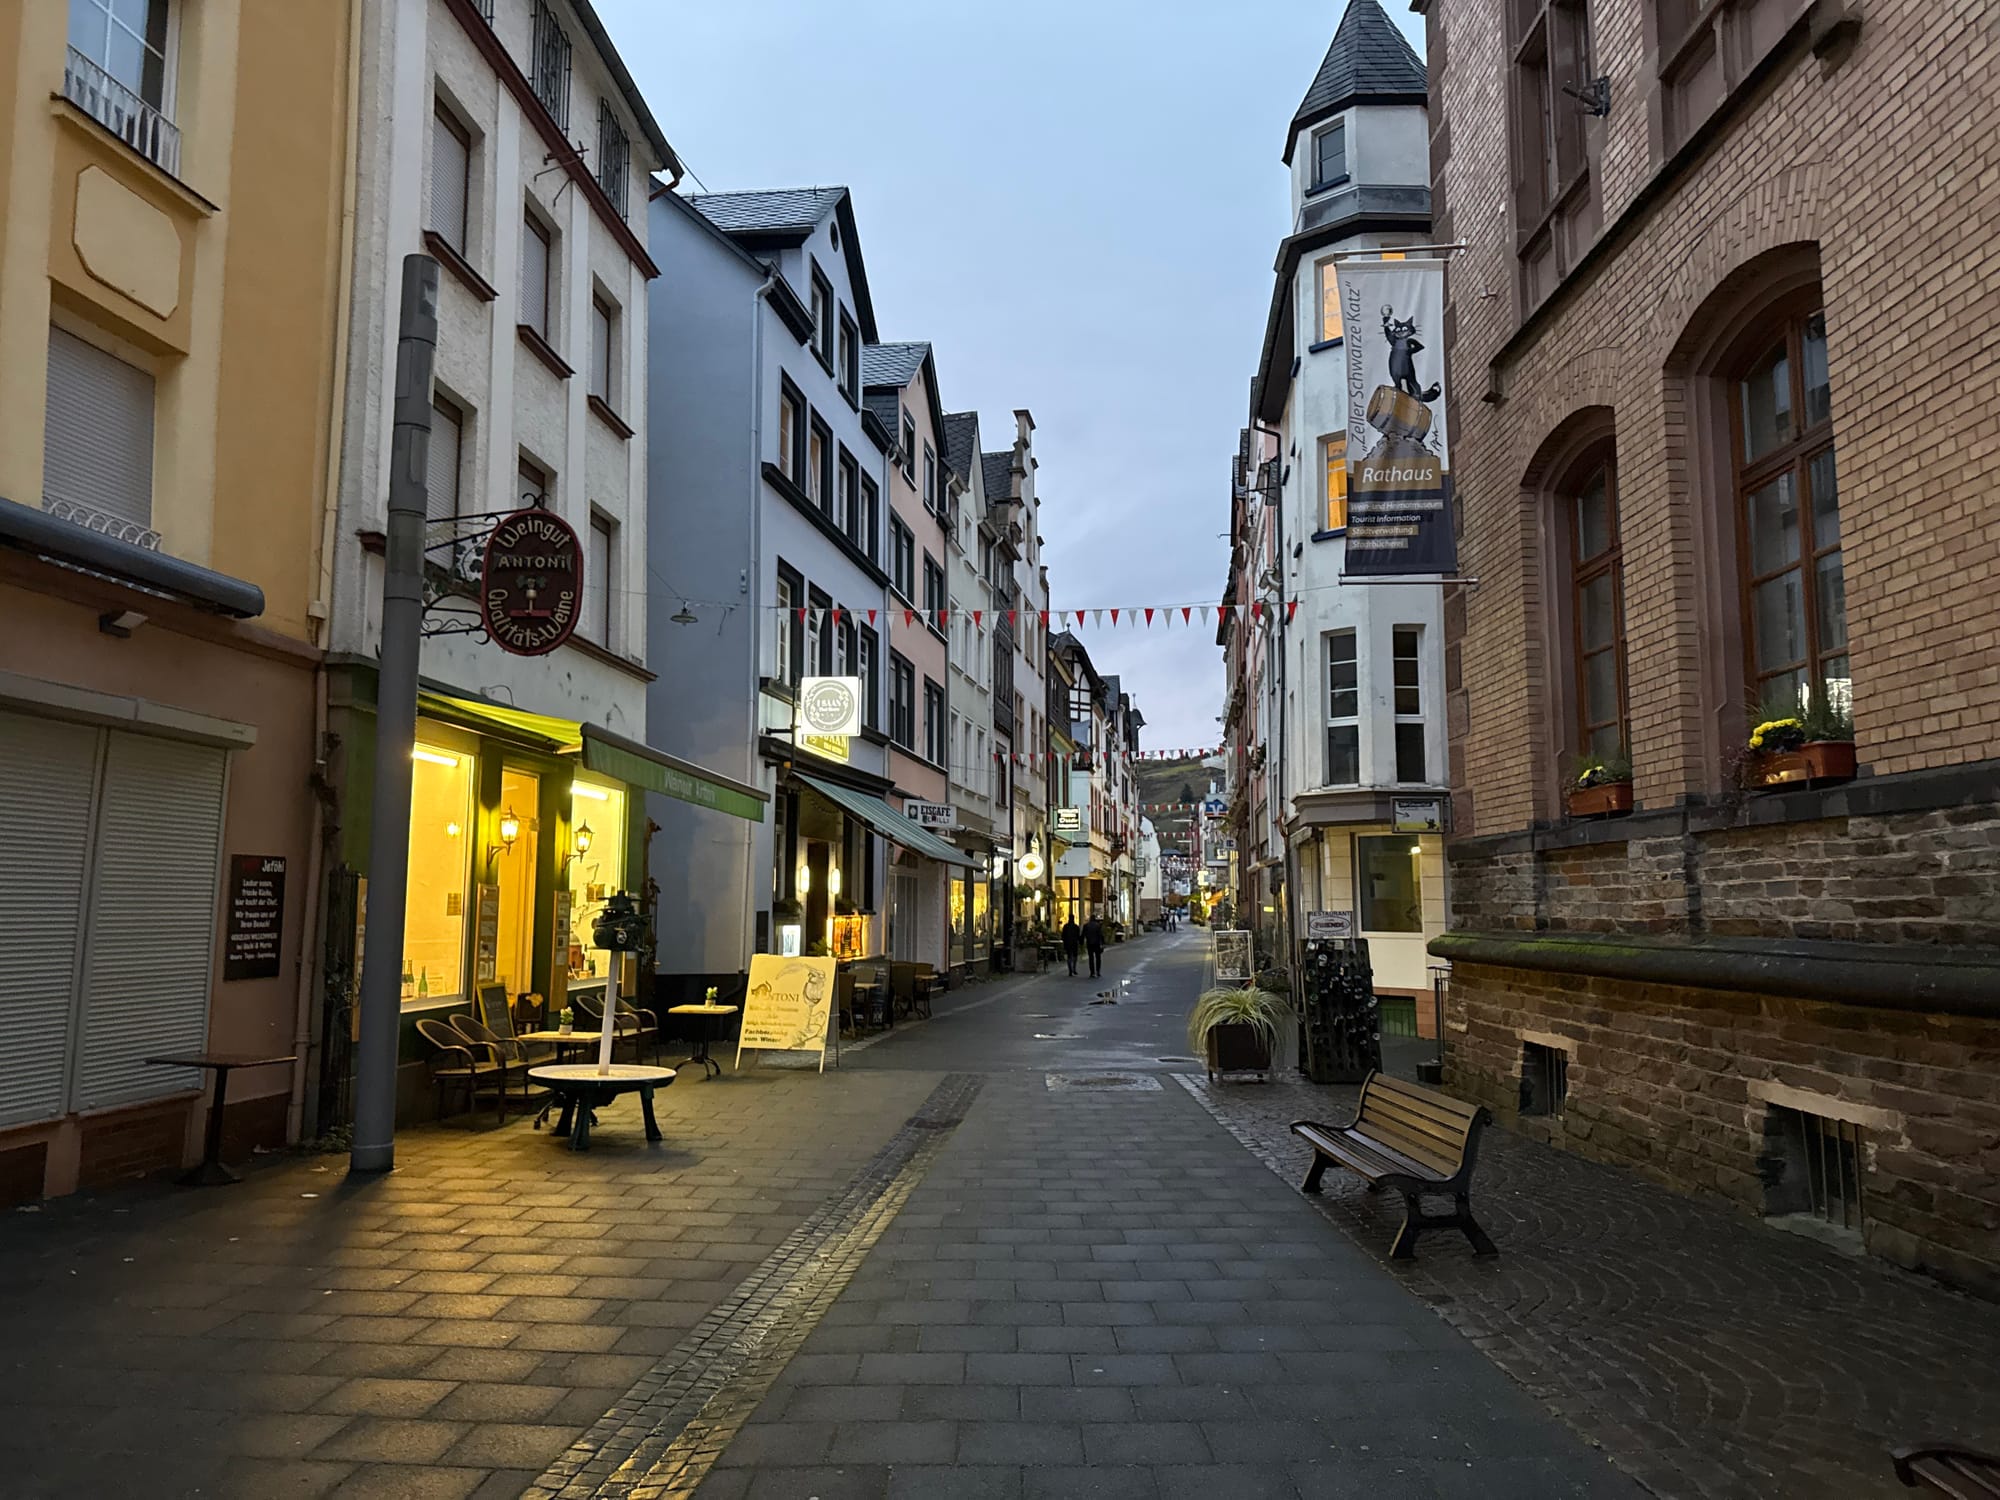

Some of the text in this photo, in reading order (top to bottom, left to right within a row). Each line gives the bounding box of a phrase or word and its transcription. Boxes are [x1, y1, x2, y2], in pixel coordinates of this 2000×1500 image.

[1347, 326, 1365, 399] Schwarze
[1362, 467, 1433, 483] Rathaus
[1351, 514, 1421, 524] Tourist Information
[495, 516, 572, 549] Weingut
[1351, 527, 1413, 536] Stadtverwaltung
[1351, 540, 1404, 549] Stadtbücherei
